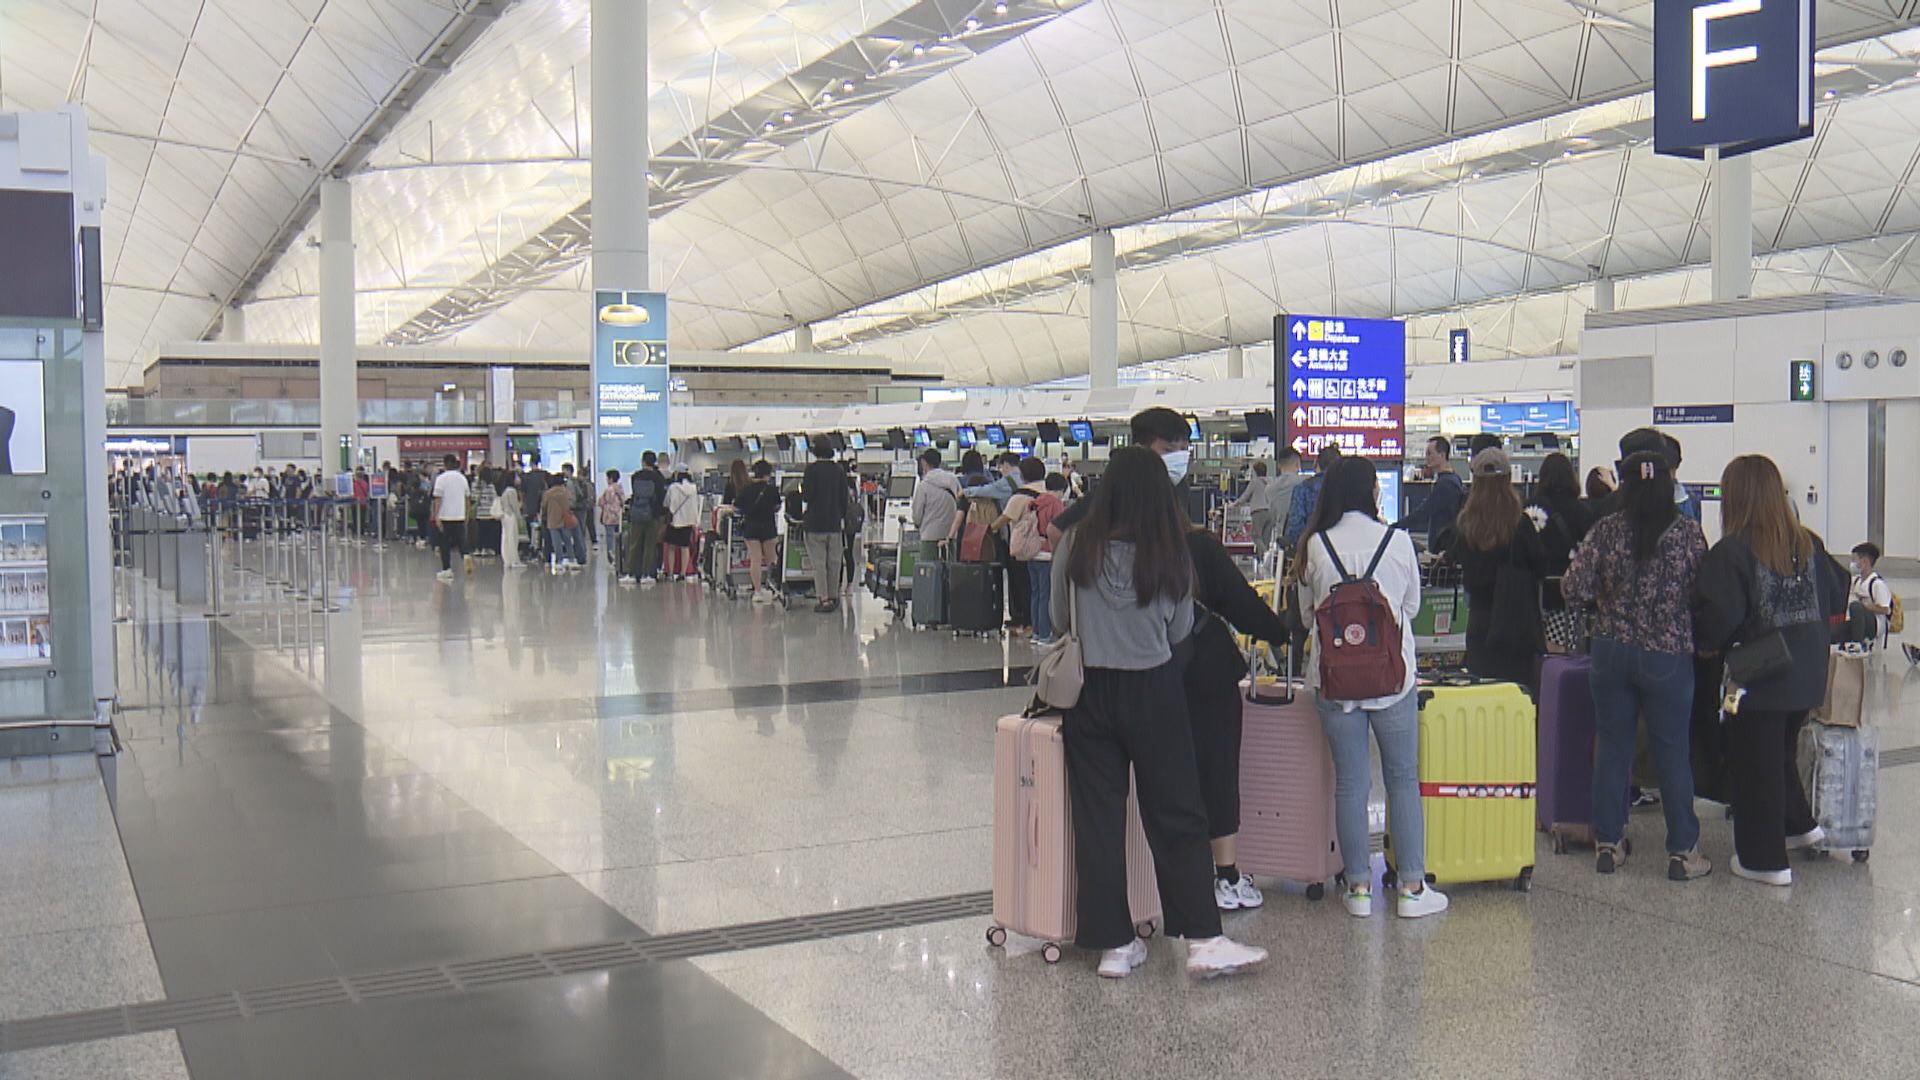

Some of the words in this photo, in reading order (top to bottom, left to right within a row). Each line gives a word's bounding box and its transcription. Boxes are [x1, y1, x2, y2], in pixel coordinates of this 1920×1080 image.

[1692, 0, 1761, 121] F
[1325, 333, 1360, 344] Departures
[1308, 361, 1334, 371] Arrivals
[1335, 361, 1348, 371] Hall
[600, 391, 660, 401] EXTRAORDINARY
